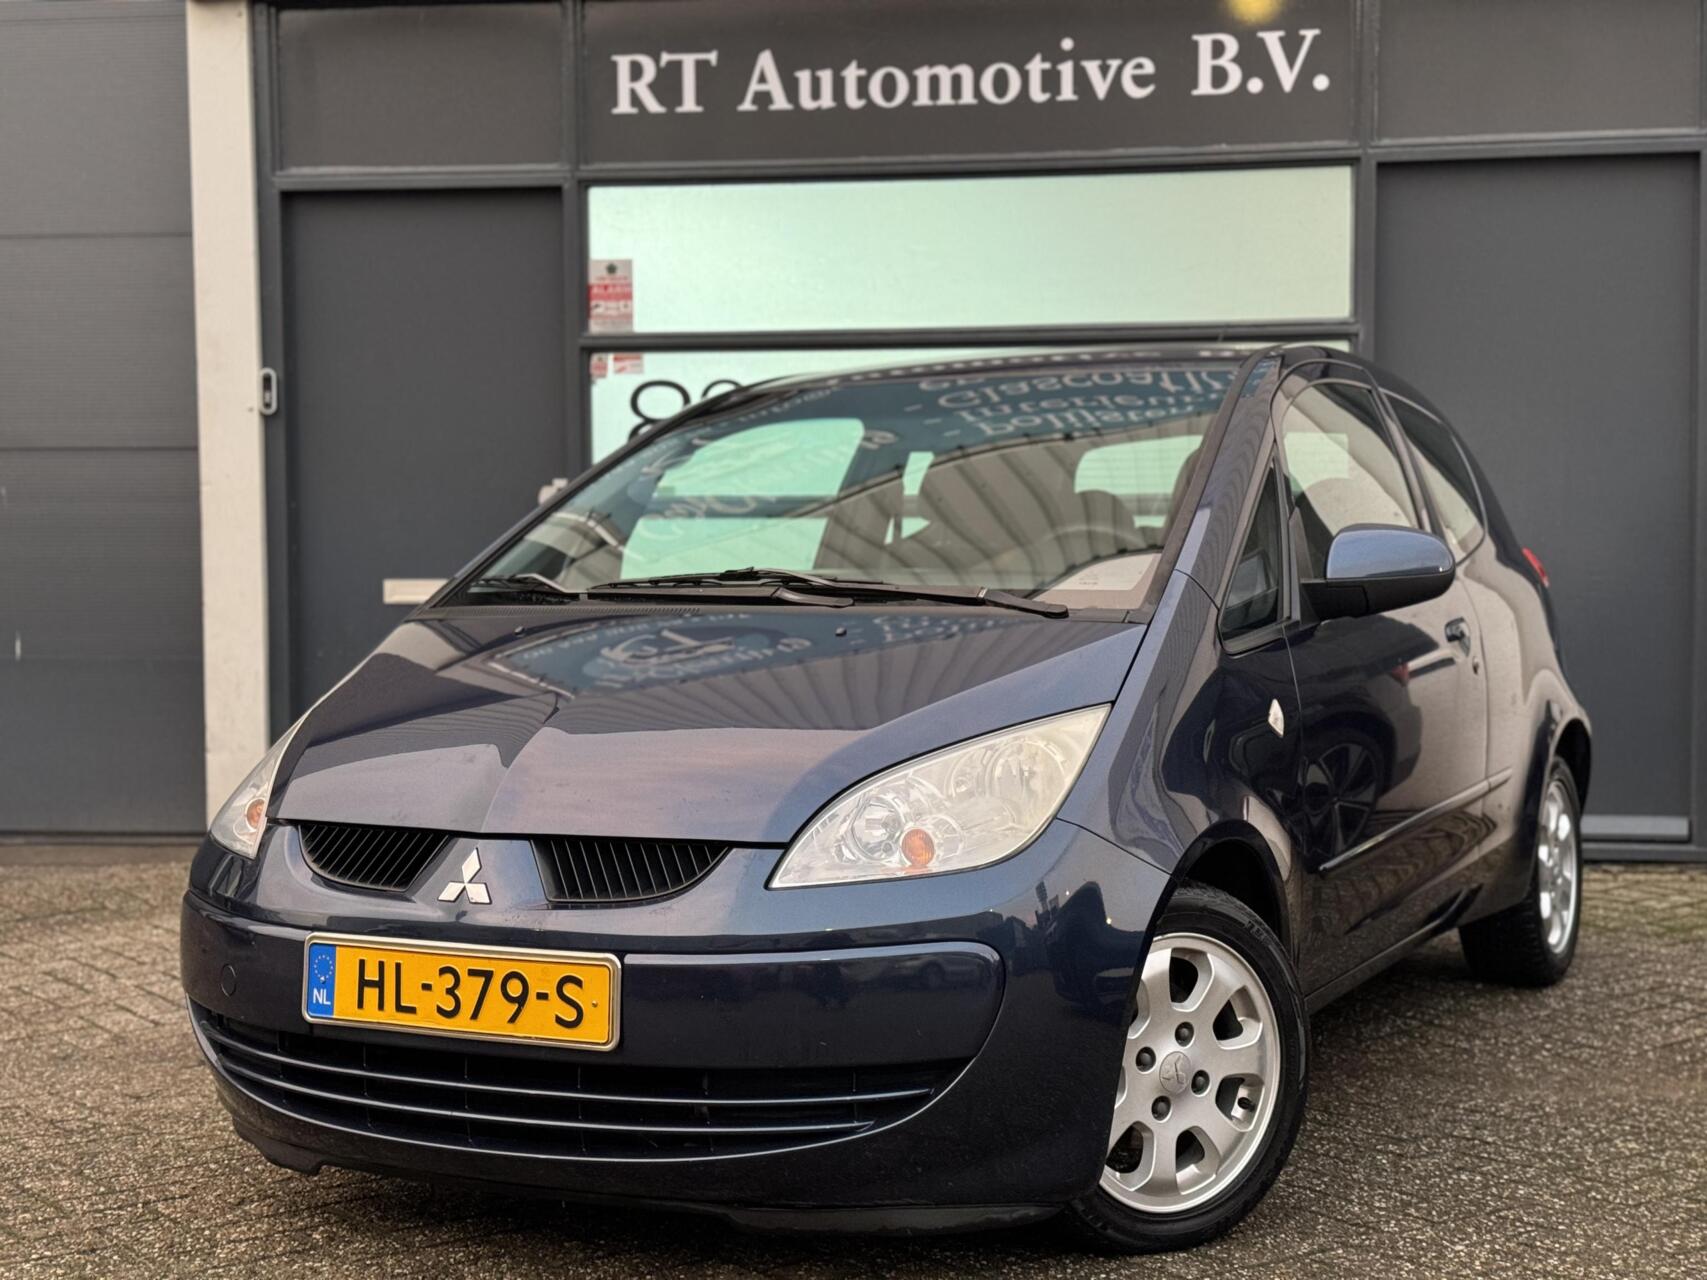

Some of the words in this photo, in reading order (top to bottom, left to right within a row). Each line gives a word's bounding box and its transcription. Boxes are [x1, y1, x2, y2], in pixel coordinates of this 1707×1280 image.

[611, 50, 717, 114] RT
[737, 37, 1156, 111] Automotive
[1190, 29, 1330, 96] B.V.
[312, 987, 332, 1006] NL
[357, 958, 585, 1029] HL-379-S
